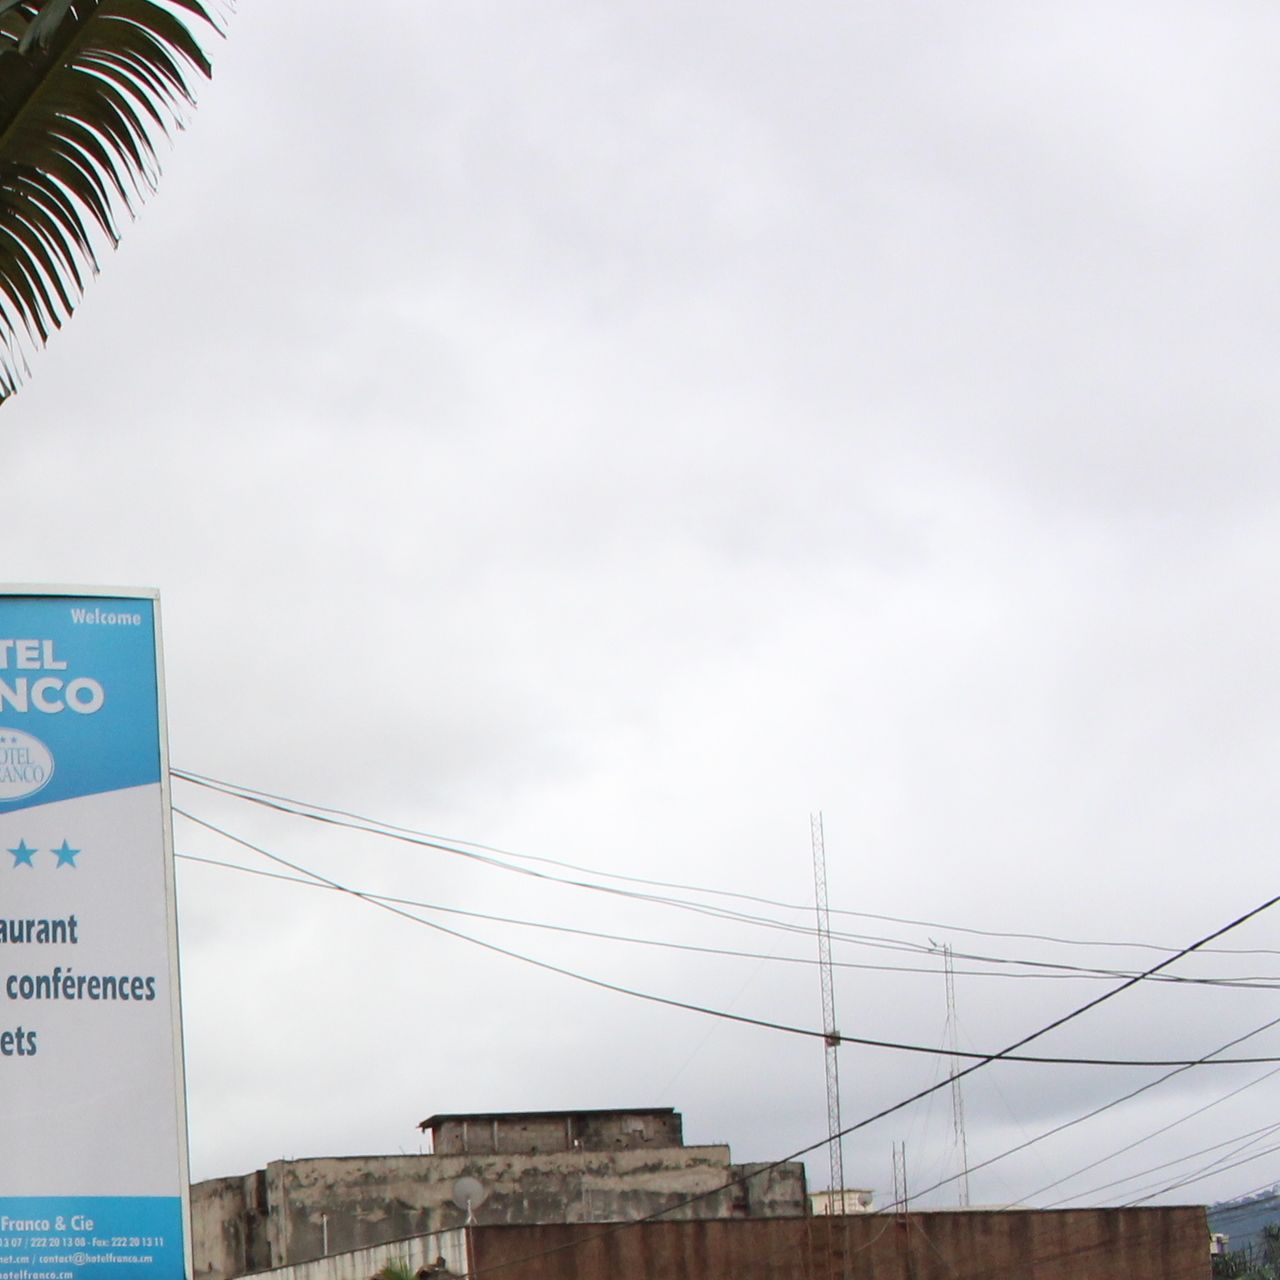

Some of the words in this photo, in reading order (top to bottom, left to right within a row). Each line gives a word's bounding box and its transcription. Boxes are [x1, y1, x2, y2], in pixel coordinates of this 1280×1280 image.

[71, 608, 142, 625] Welcome
[6, 967, 156, 1001] conférences
[1, 1216, 50, 1232] Franco
[54, 1215, 66, 1231] &
[71, 1215, 94, 1231] Cie
[0, 1238, 10, 1248] 13
[10, 1238, 23, 1248] 07
[30, 1237, 48, 1248] 222
[49, 1237, 60, 1248] 20
[62, 1237, 73, 1248] 13
[111, 1237, 129, 1247] 222
[129, 1237, 140, 1247] 20
[142, 1237, 153, 1247] 13
[154, 1237, 164, 1247] 11
